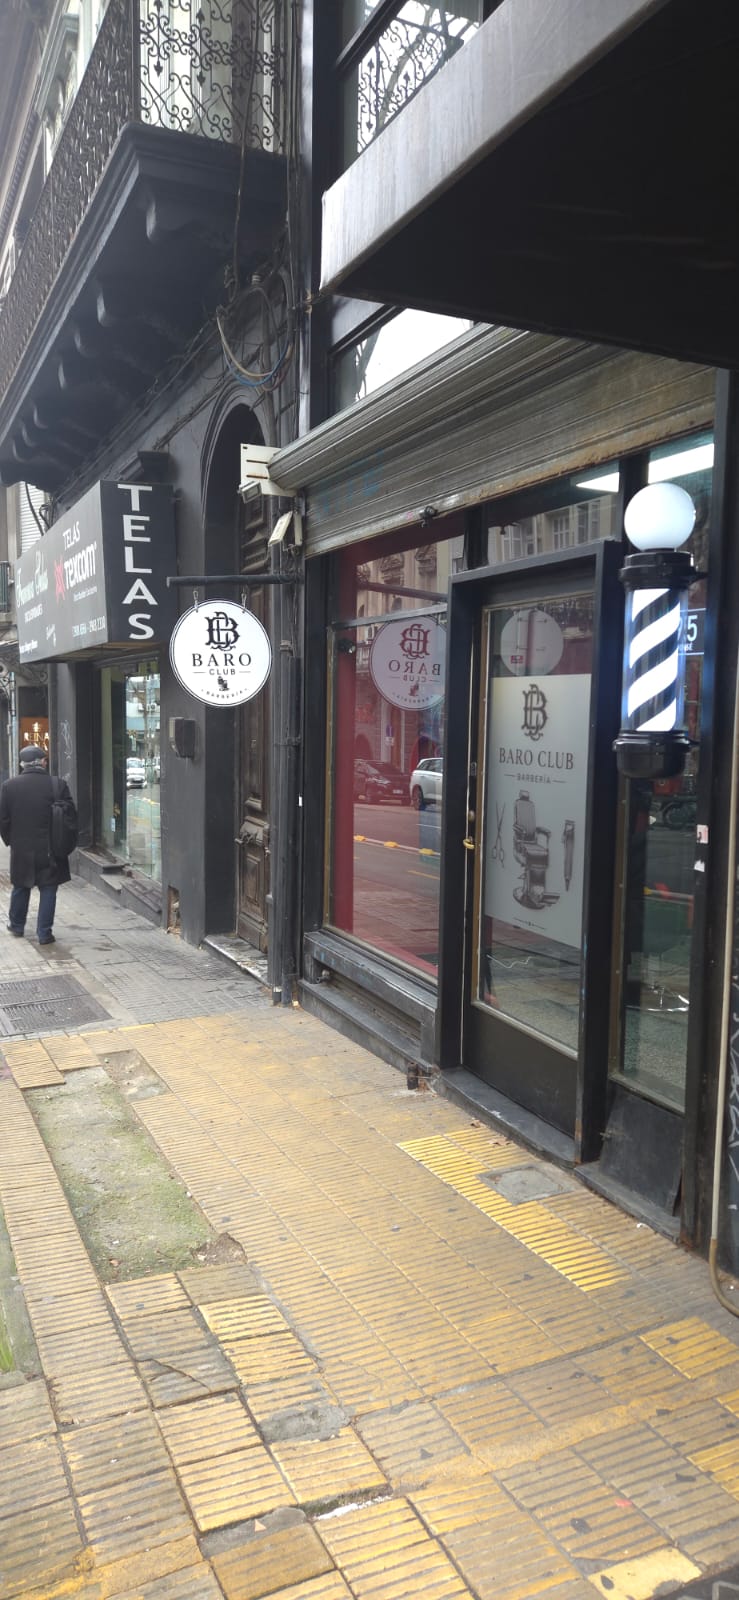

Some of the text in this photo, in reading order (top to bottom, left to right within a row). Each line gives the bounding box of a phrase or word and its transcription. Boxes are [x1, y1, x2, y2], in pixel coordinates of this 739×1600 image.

[62, 520, 81, 551] TELAS
[117, 483, 158, 641] TELAS
[192, 653, 252, 667] BARO
[209, 668, 236, 676] CLUB
[499, 747, 574, 770] BARO CLUB
